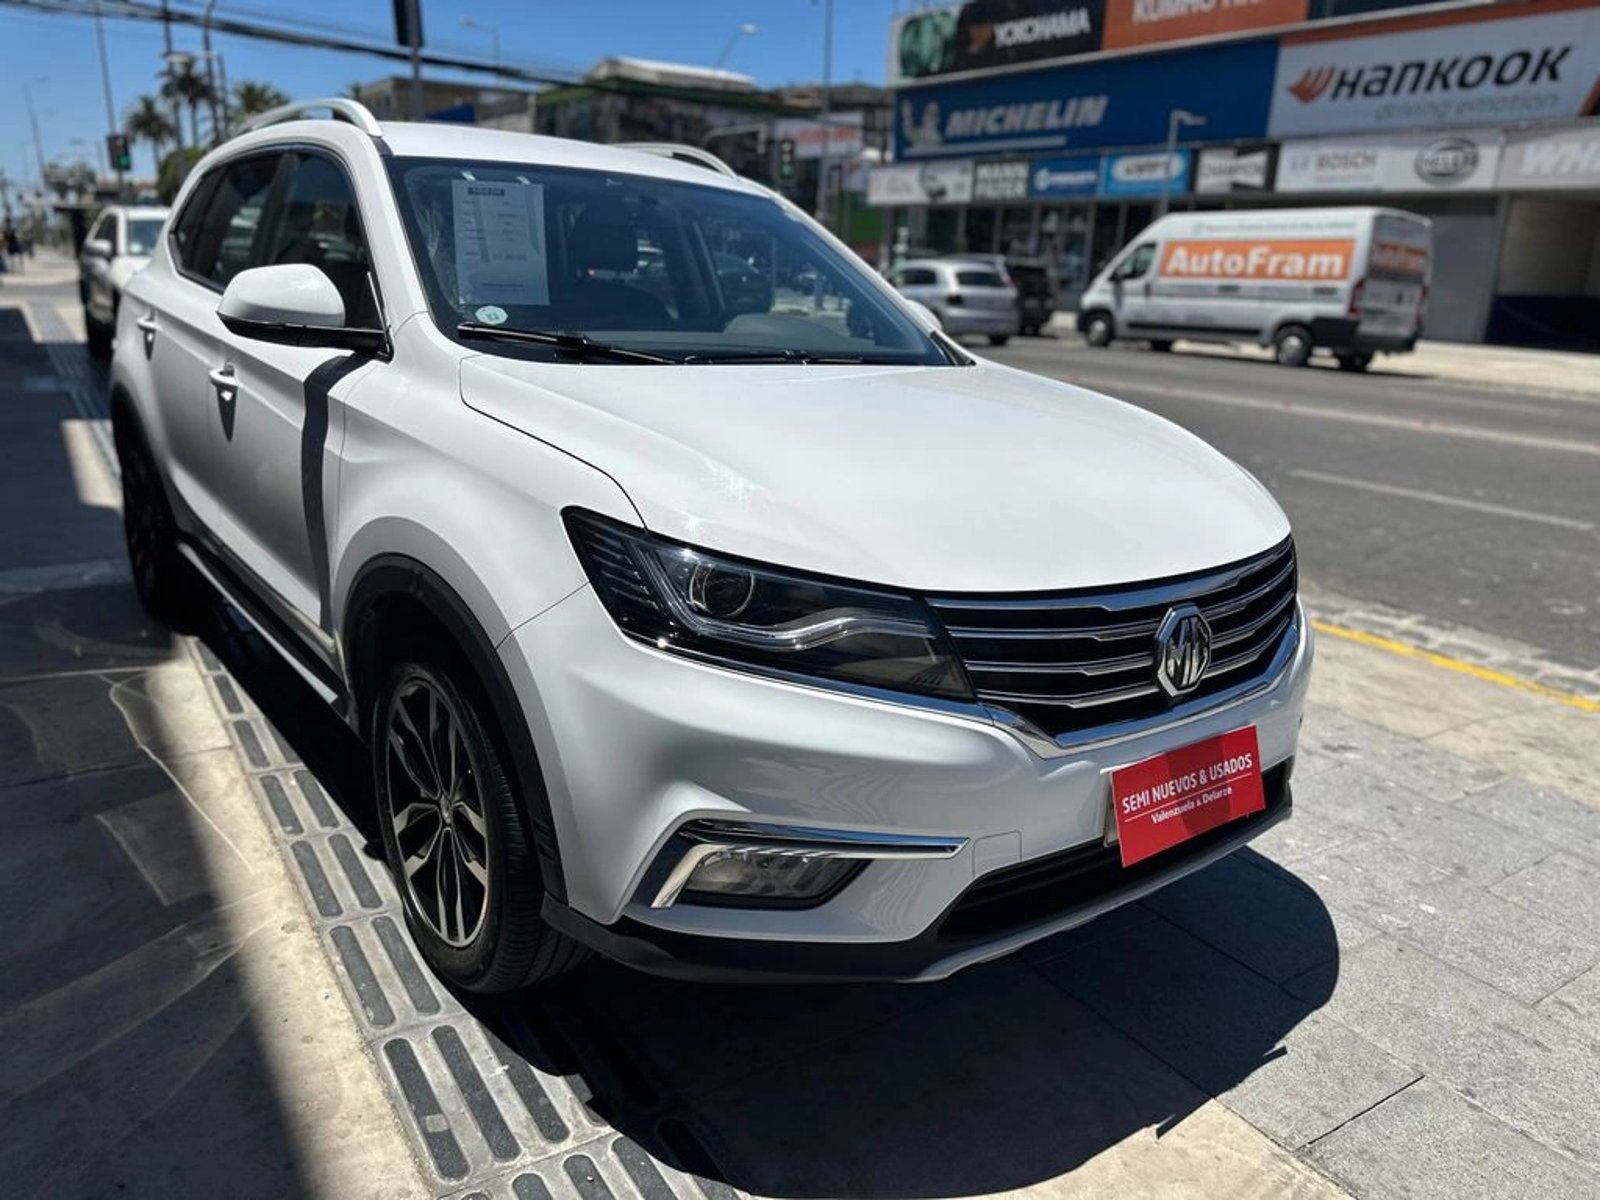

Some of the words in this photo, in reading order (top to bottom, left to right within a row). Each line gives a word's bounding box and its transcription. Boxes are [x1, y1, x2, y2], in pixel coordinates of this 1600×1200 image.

[994, 8, 1091, 47] YOKOHAMA
[945, 95, 1109, 138] MICHELIN
[1315, 150, 1377, 172] BOSCH
[1165, 247, 1343, 277] AutoFram
[1122, 789, 1150, 815] SEMI
[1152, 773, 1198, 803] NUEVOS
[1199, 769, 1208, 785] &
[1208, 753, 1253, 781] USADOS
